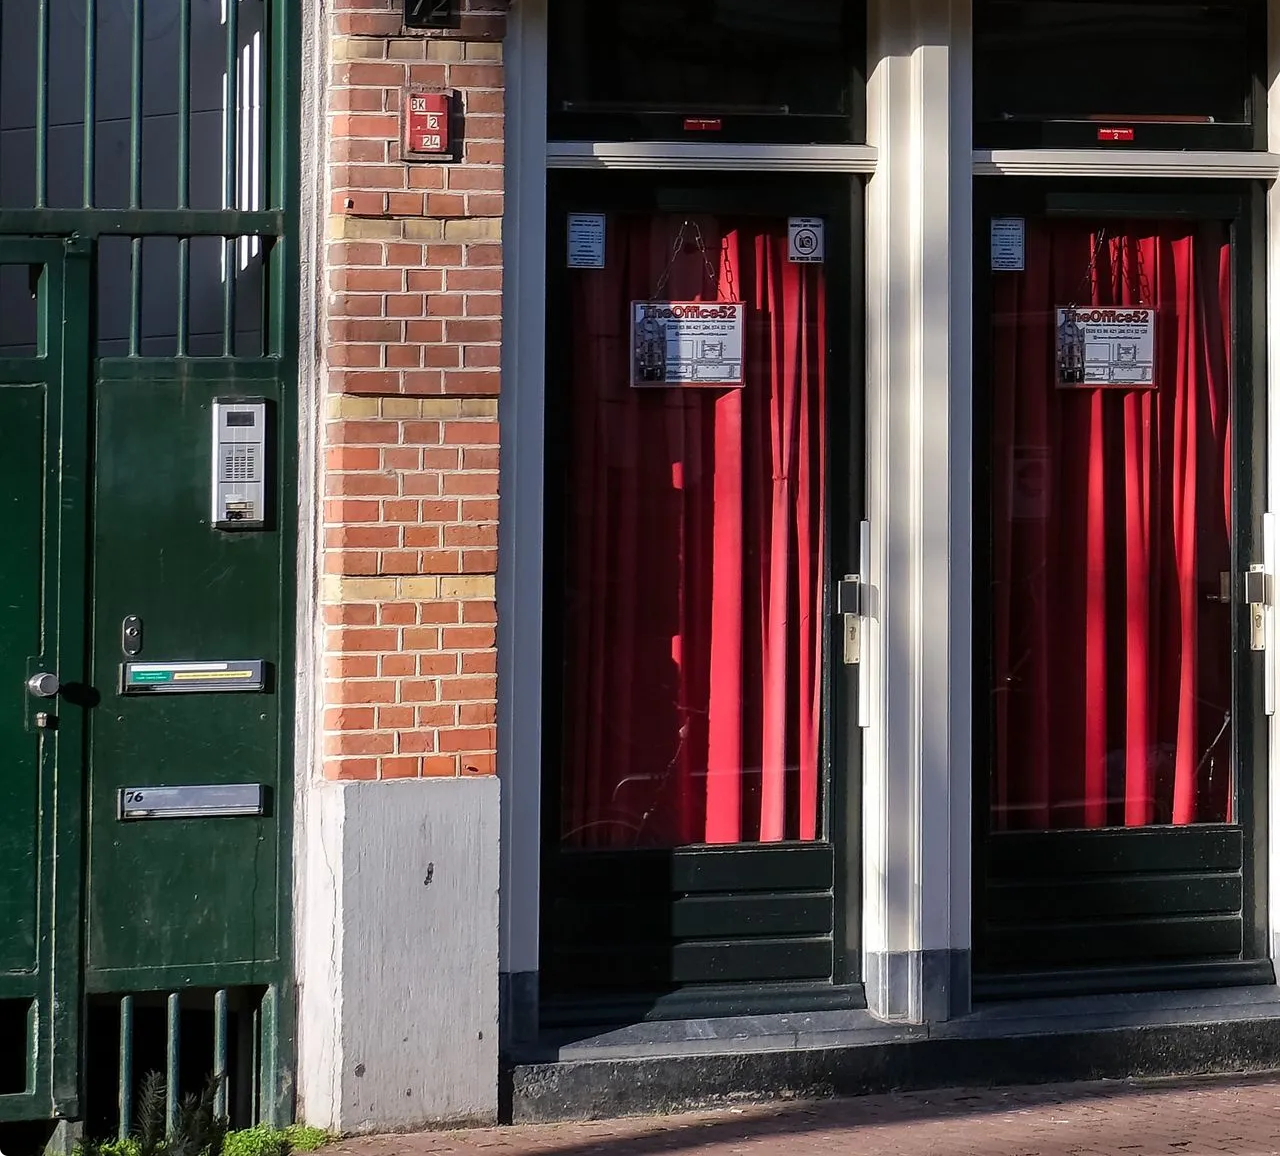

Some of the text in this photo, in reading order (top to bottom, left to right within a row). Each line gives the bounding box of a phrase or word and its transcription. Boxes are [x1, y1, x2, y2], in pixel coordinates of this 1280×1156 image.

[411, 98, 425, 111] BK
[430, 117, 437, 129] 2
[126, 791, 144, 804] 76
